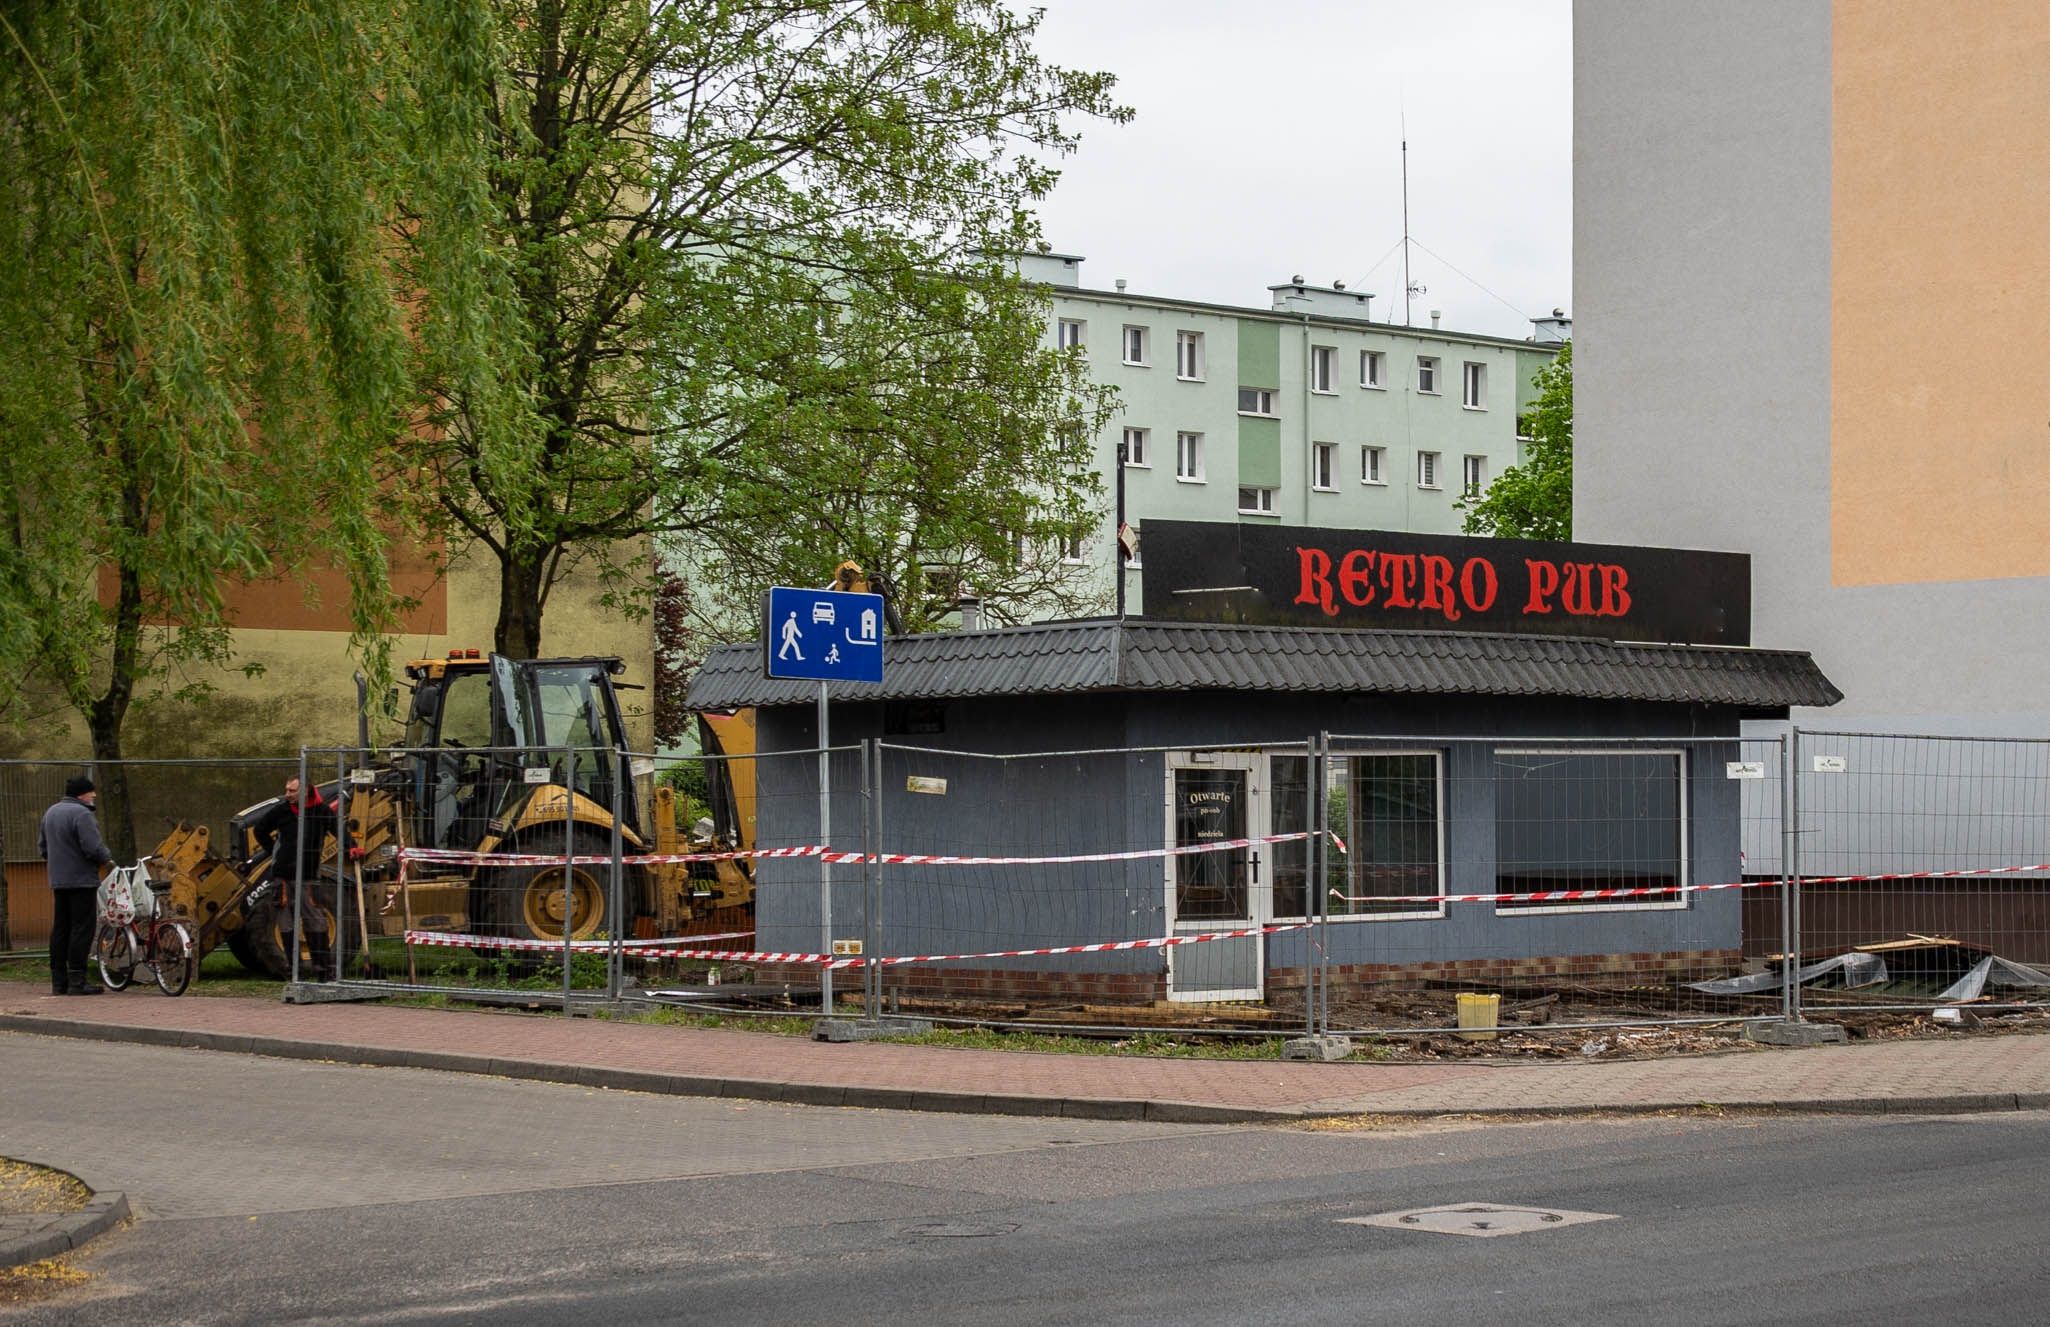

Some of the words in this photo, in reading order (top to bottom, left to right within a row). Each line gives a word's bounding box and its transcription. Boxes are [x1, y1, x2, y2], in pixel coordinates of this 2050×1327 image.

[1294, 546, 1498, 621] RETRO
[1523, 558, 1632, 617] PUB
[1190, 791, 1231, 804] Otwarte
